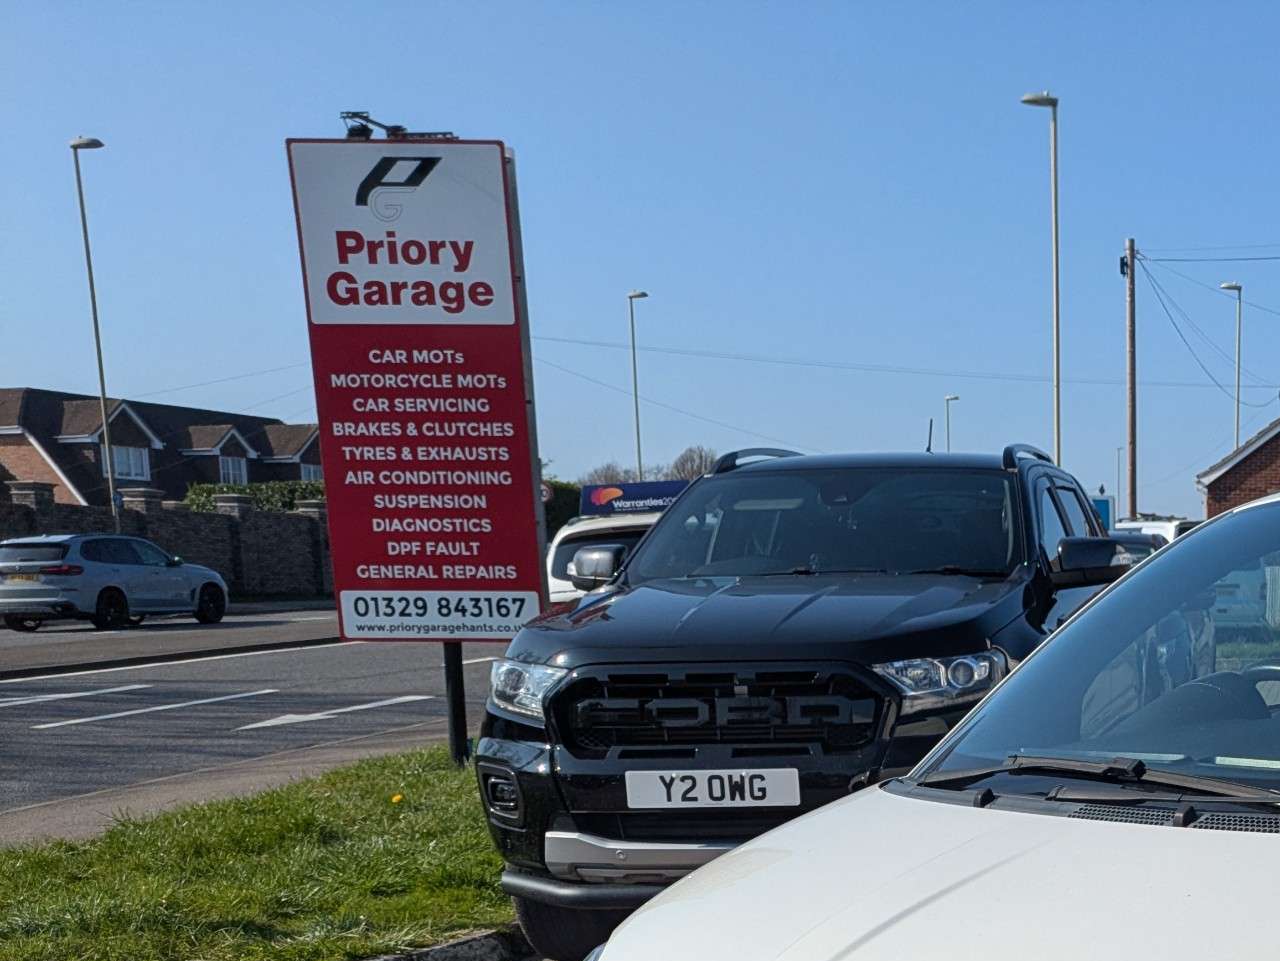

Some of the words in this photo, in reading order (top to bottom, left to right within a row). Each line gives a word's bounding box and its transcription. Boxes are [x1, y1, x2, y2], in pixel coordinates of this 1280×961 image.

[335, 230, 474, 272] Priory
[326, 271, 494, 314] Garage
[368, 349, 408, 364] CAR
[412, 349, 465, 364] MOTs
[330, 373, 453, 389] MOTORCYCLE
[457, 374, 507, 389] MOTs
[352, 397, 391, 413] CAR
[394, 397, 490, 413] SERVICING
[332, 422, 402, 437] BRAKES
[406, 421, 418, 437] &
[421, 422, 515, 437] CLUTCHES
[341, 446, 397, 461] TYRES
[401, 446, 413, 461] &
[417, 446, 510, 461] EXHAUSTS
[344, 470, 376, 485] AIR
[378, 470, 513, 485] CONDITIONING
[373, 494, 487, 509] SUSPENSION
[371, 518, 492, 533] DIAGNOSTICS
[386, 541, 422, 556] DPF
[425, 541, 481, 556] FAULT
[356, 564, 439, 579] GENERAL
[441, 565, 518, 580] REPAIRS
[353, 596, 428, 618] 01329
[437, 596, 526, 618] 843167
[355, 622, 525, 635] www.priorygaragehants.co.u
[659, 774, 699, 803] Y2
[707, 773, 767, 802] OWG
